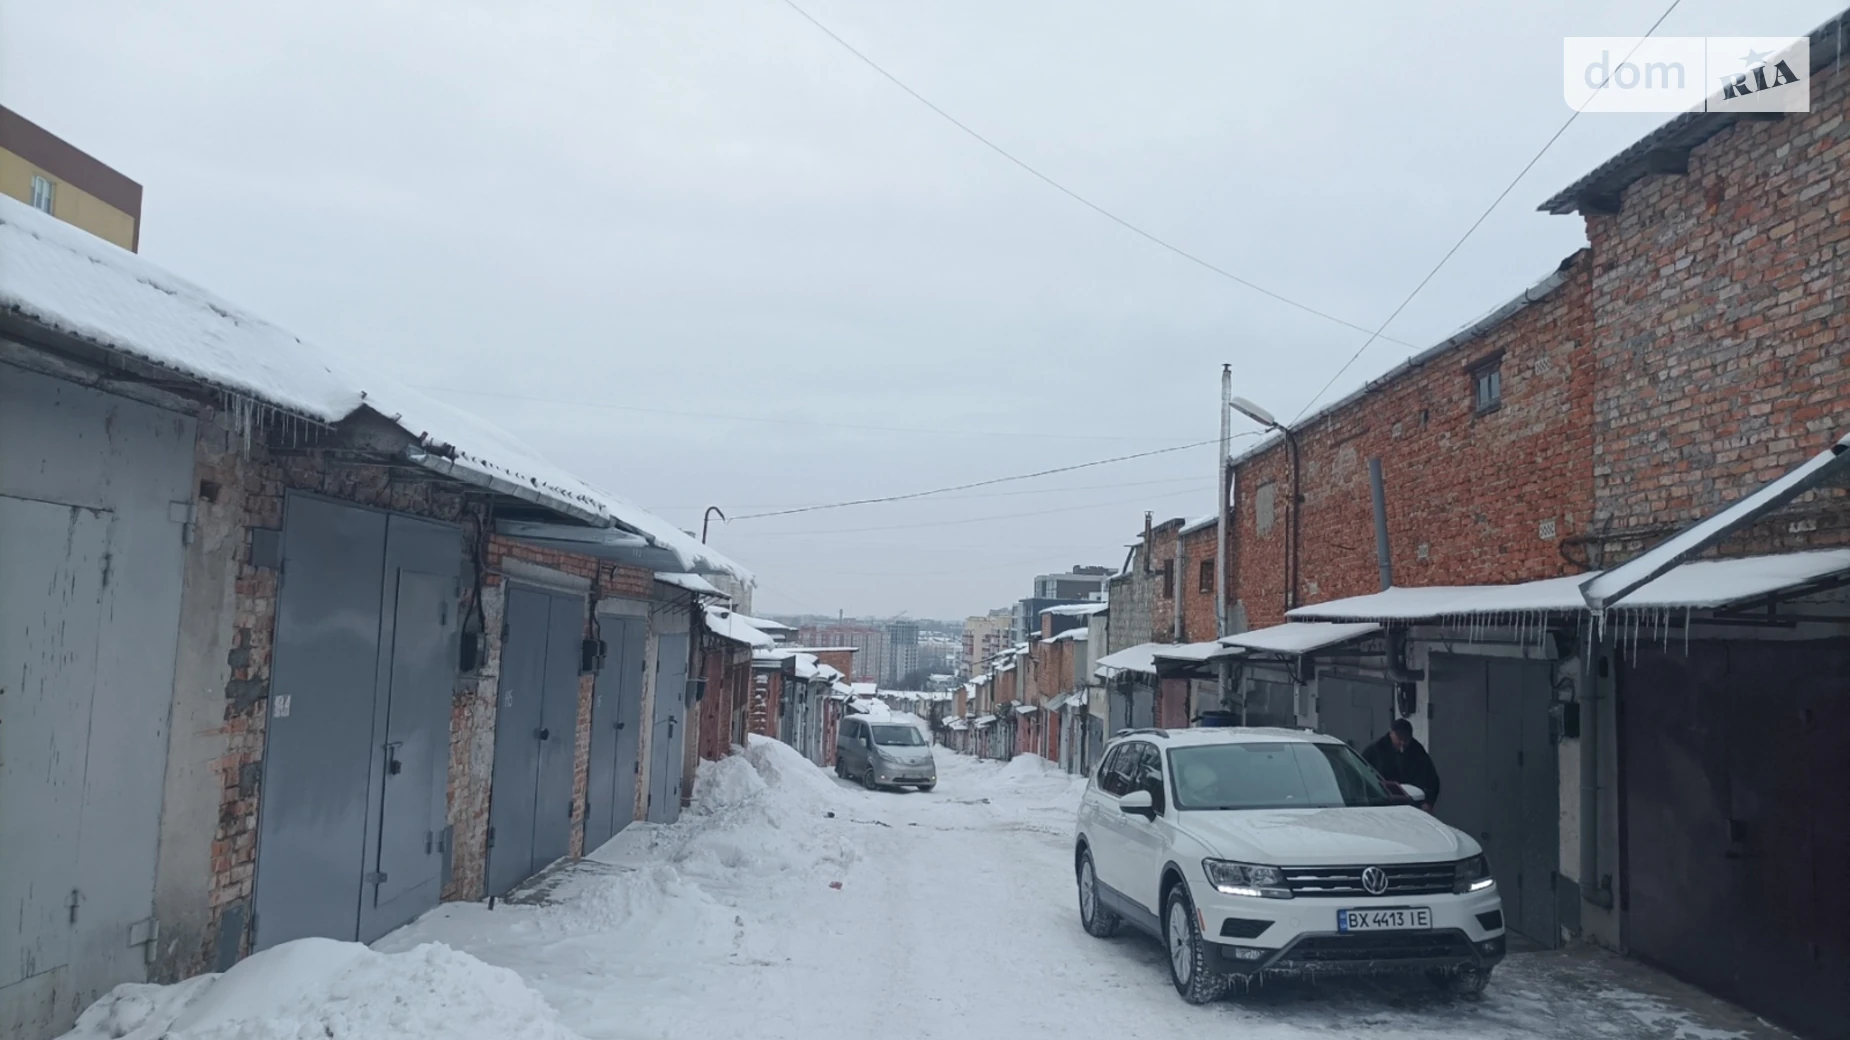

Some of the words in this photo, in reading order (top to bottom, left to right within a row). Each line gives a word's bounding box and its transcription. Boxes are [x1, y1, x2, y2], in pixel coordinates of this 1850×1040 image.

[1348, 913, 1369, 928] BX
[1372, 911, 1404, 927] 4413
[1410, 910, 1428, 926] IE
